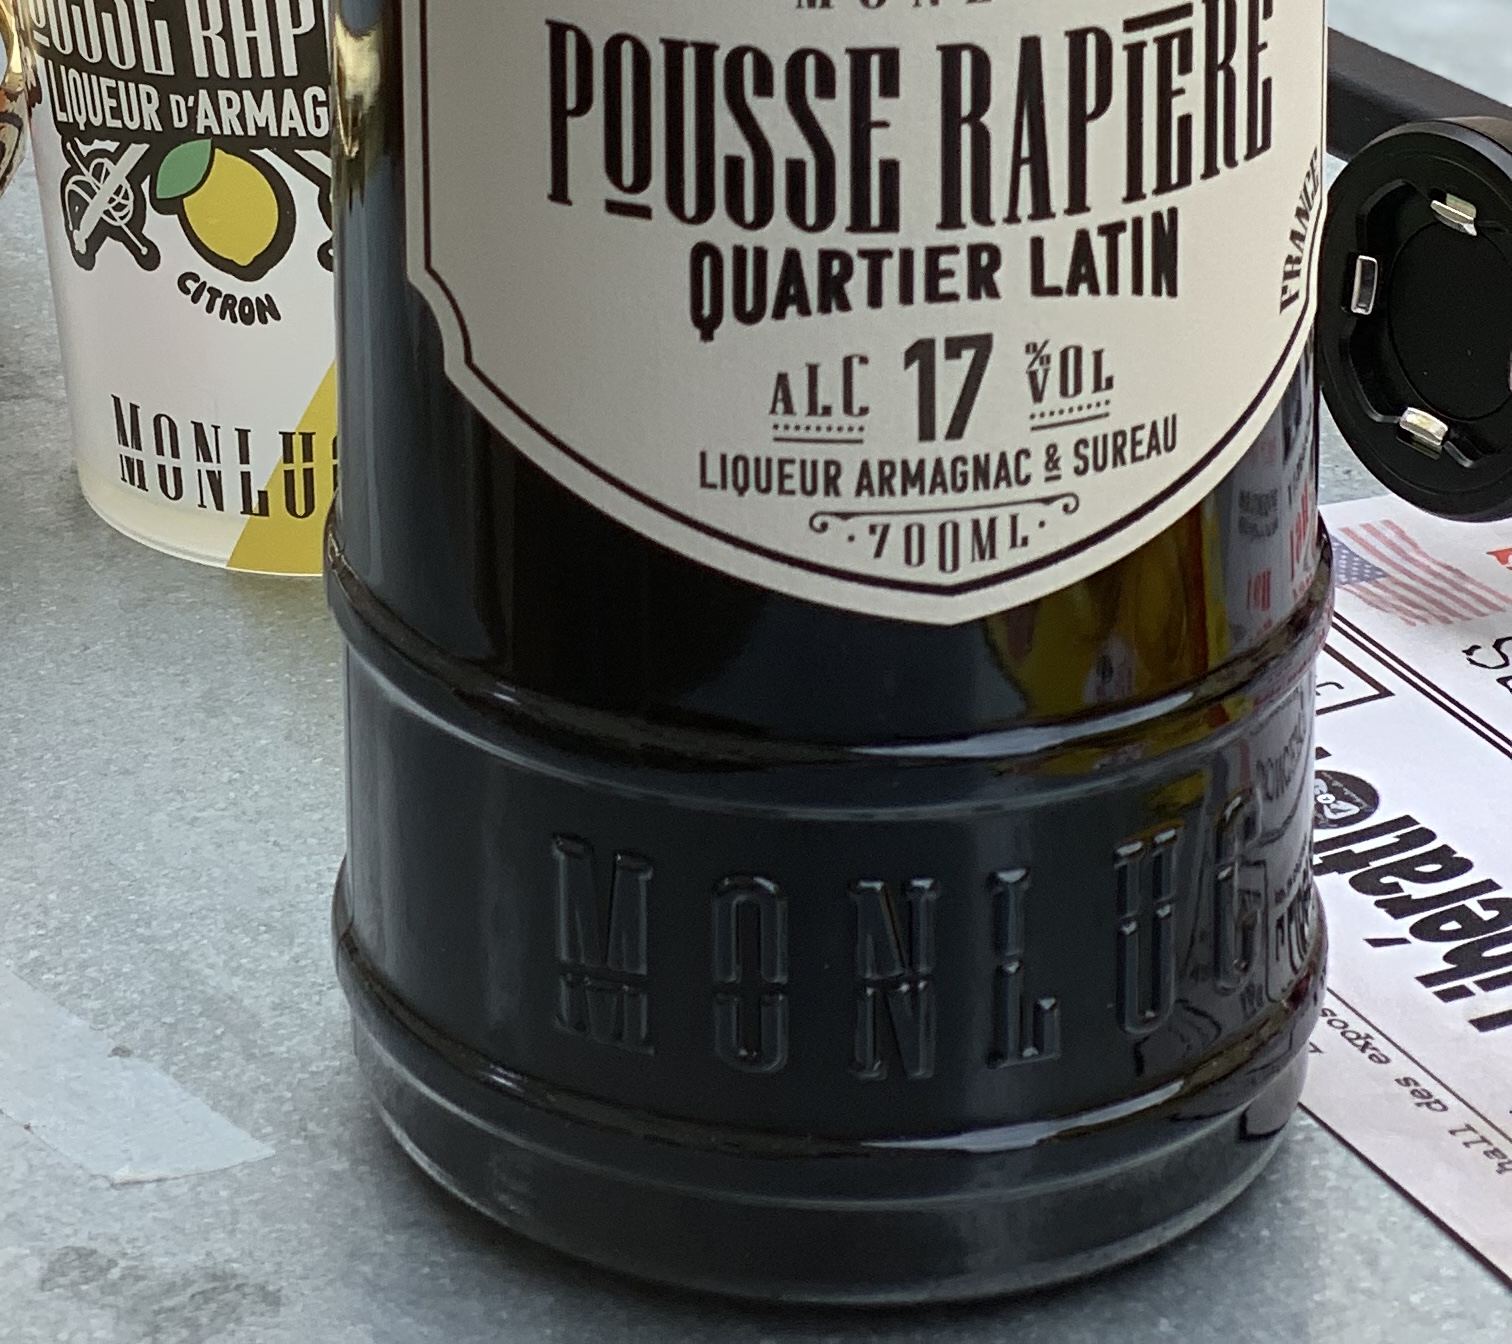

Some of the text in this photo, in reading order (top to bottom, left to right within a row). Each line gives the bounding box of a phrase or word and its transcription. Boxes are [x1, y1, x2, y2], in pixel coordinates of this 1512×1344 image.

[48, 58, 330, 138] LIQUEUR D'ARMAG
[545, 18, 901, 234] POUSSE
[689, 206, 1180, 343] QUARTIER LATIN
[1278, 146, 1320, 315] FRANCE
[176, 270, 282, 327] CITRON
[768, 353, 871, 418] ALC
[902, 332, 995, 443] 17
[110, 393, 337, 520] MONLU
[698, 412, 1179, 498] LIQUEUR ARMAGNAC & SUREAU
[867, 513, 1031, 575] 700ML
[551, 787, 1263, 1083] MONLUC
[1394, 1076, 1450, 1113] des
